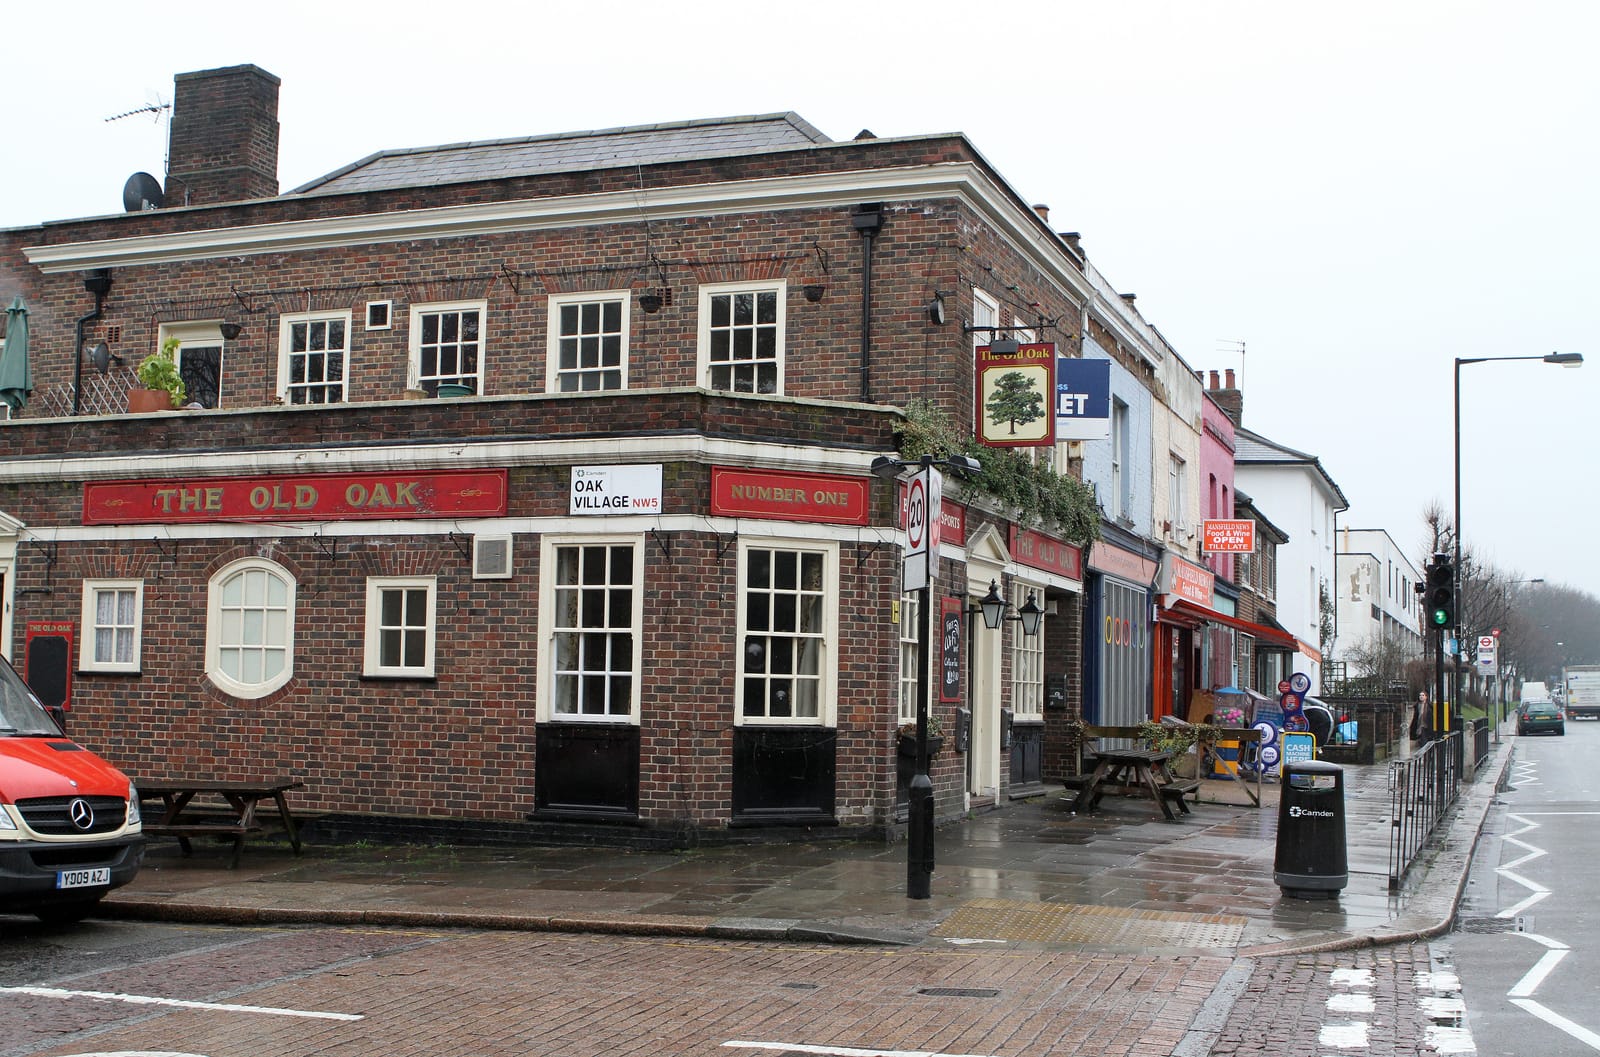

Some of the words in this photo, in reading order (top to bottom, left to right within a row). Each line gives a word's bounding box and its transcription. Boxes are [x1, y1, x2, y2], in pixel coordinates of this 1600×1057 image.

[1026, 348, 1050, 359] Oak
[1057, 394, 1089, 415] ET
[575, 480, 603, 492] OAK
[731, 484, 808, 504] NUMBER
[813, 491, 849, 506] ONE
[154, 487, 224, 513] THE
[249, 485, 318, 511] OLD
[345, 482, 422, 508] OAK
[575, 496, 629, 508] VILLAGE
[632, 498, 658, 507] NW5
[910, 498, 922, 528] 20
[941, 511, 960, 529] SPORTS
[1016, 535, 1034, 558] THE
[64, 872, 89, 886] YD09
[91, 869, 109, 883] AZJ
